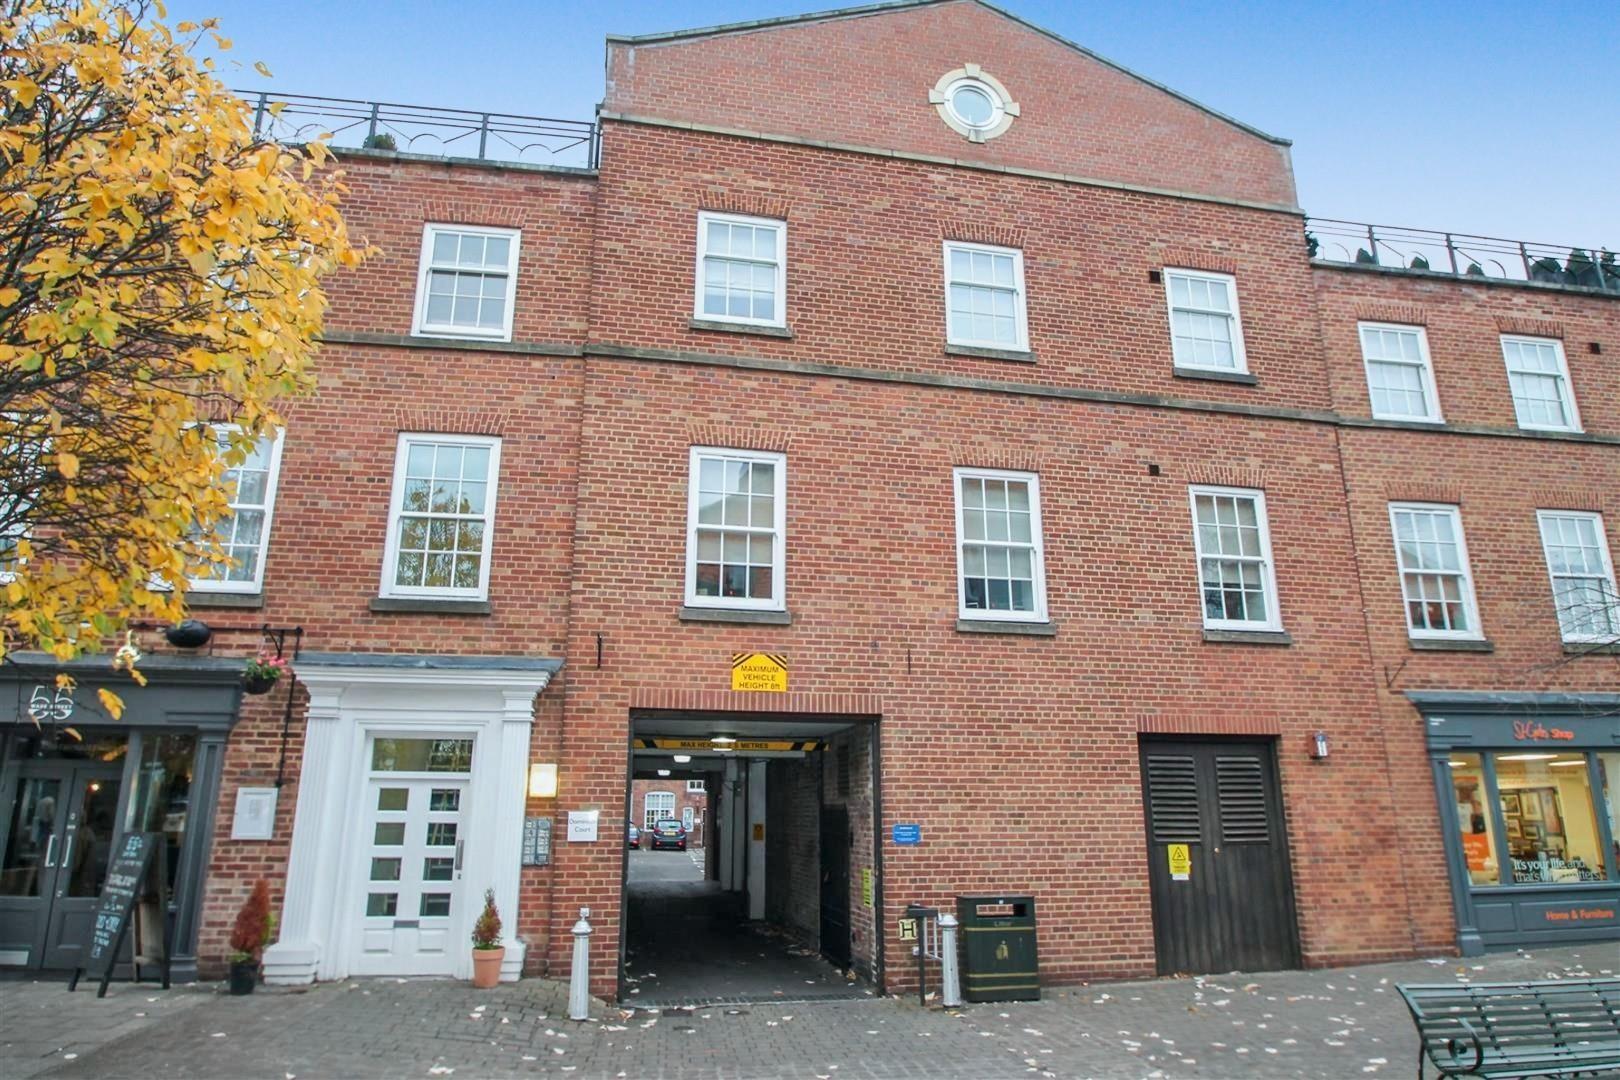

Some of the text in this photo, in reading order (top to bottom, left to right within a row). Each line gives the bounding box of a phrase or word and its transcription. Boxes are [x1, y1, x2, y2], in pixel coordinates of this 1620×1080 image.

[741, 665, 779, 673] MAXIMUM
[743, 673, 776, 681] VEHICLE
[739, 681, 768, 689] HEIGHT
[1527, 860, 1549, 872] your
[901, 921, 917, 938] H
